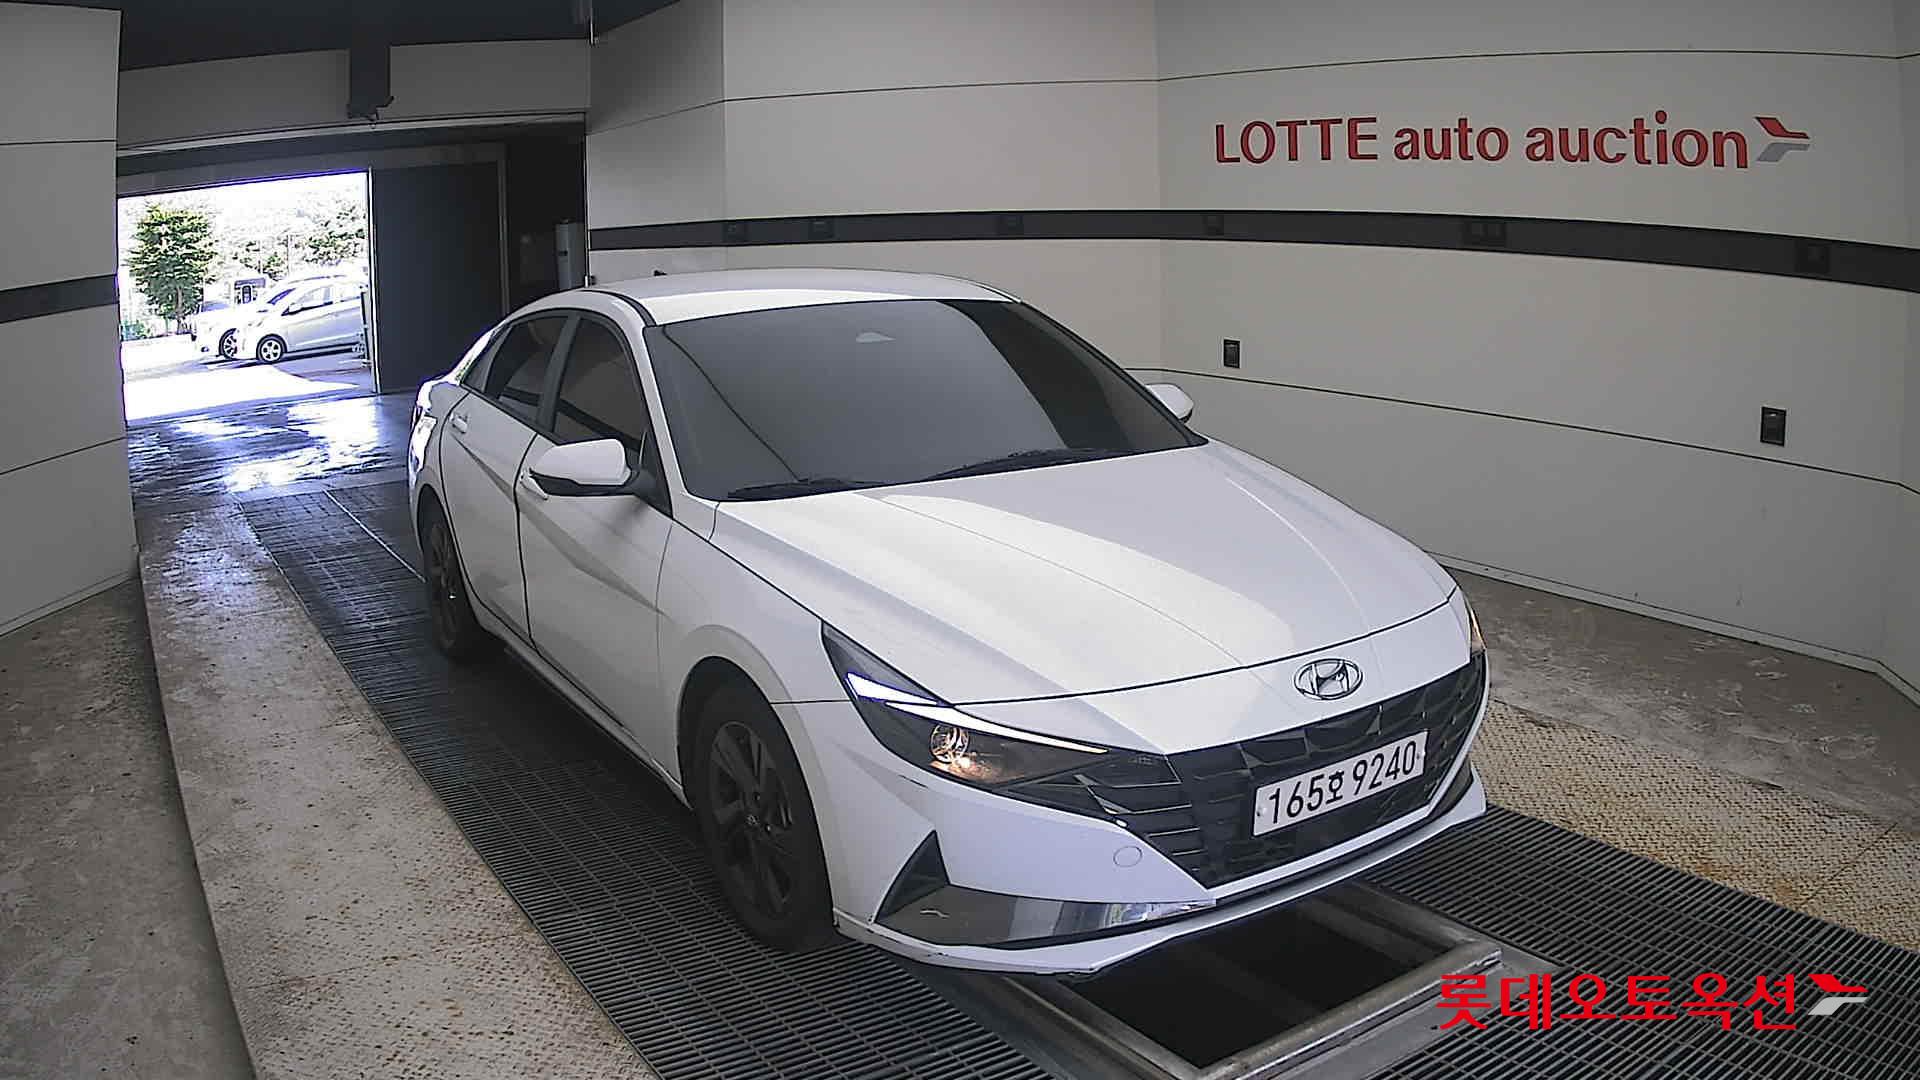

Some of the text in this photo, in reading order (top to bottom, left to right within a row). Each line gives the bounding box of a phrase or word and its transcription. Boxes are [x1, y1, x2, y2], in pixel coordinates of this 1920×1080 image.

[1215, 110, 1748, 168] LOTTE auto auction
[1268, 740, 1417, 824] 165호 9240
